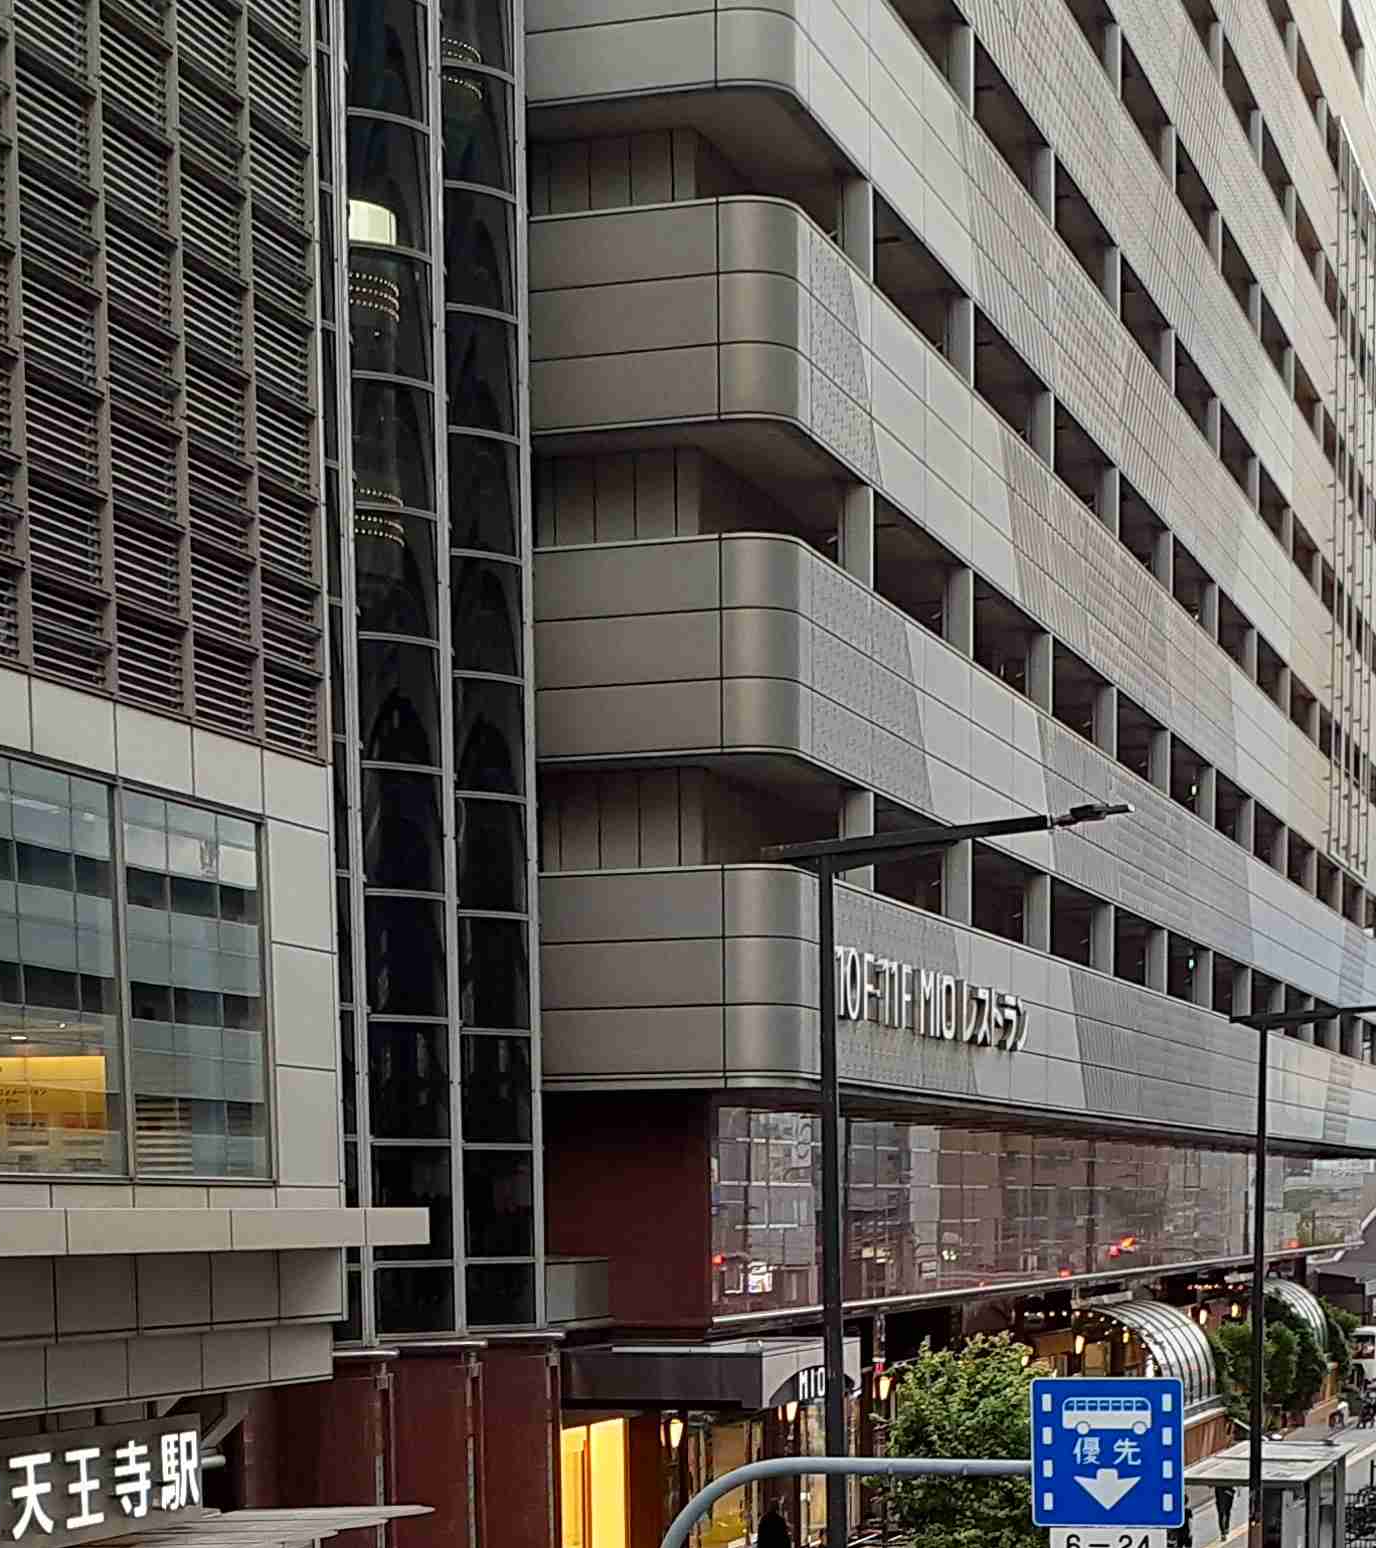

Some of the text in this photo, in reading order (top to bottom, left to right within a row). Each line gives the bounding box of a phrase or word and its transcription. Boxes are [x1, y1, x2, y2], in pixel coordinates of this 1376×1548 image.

[920, 968, 956, 1041] MIO
[799, 1366, 826, 1401] MIO
[1073, 1436, 1142, 1466] 優先
[8, 1430, 201, 1543] 天王寺駅
